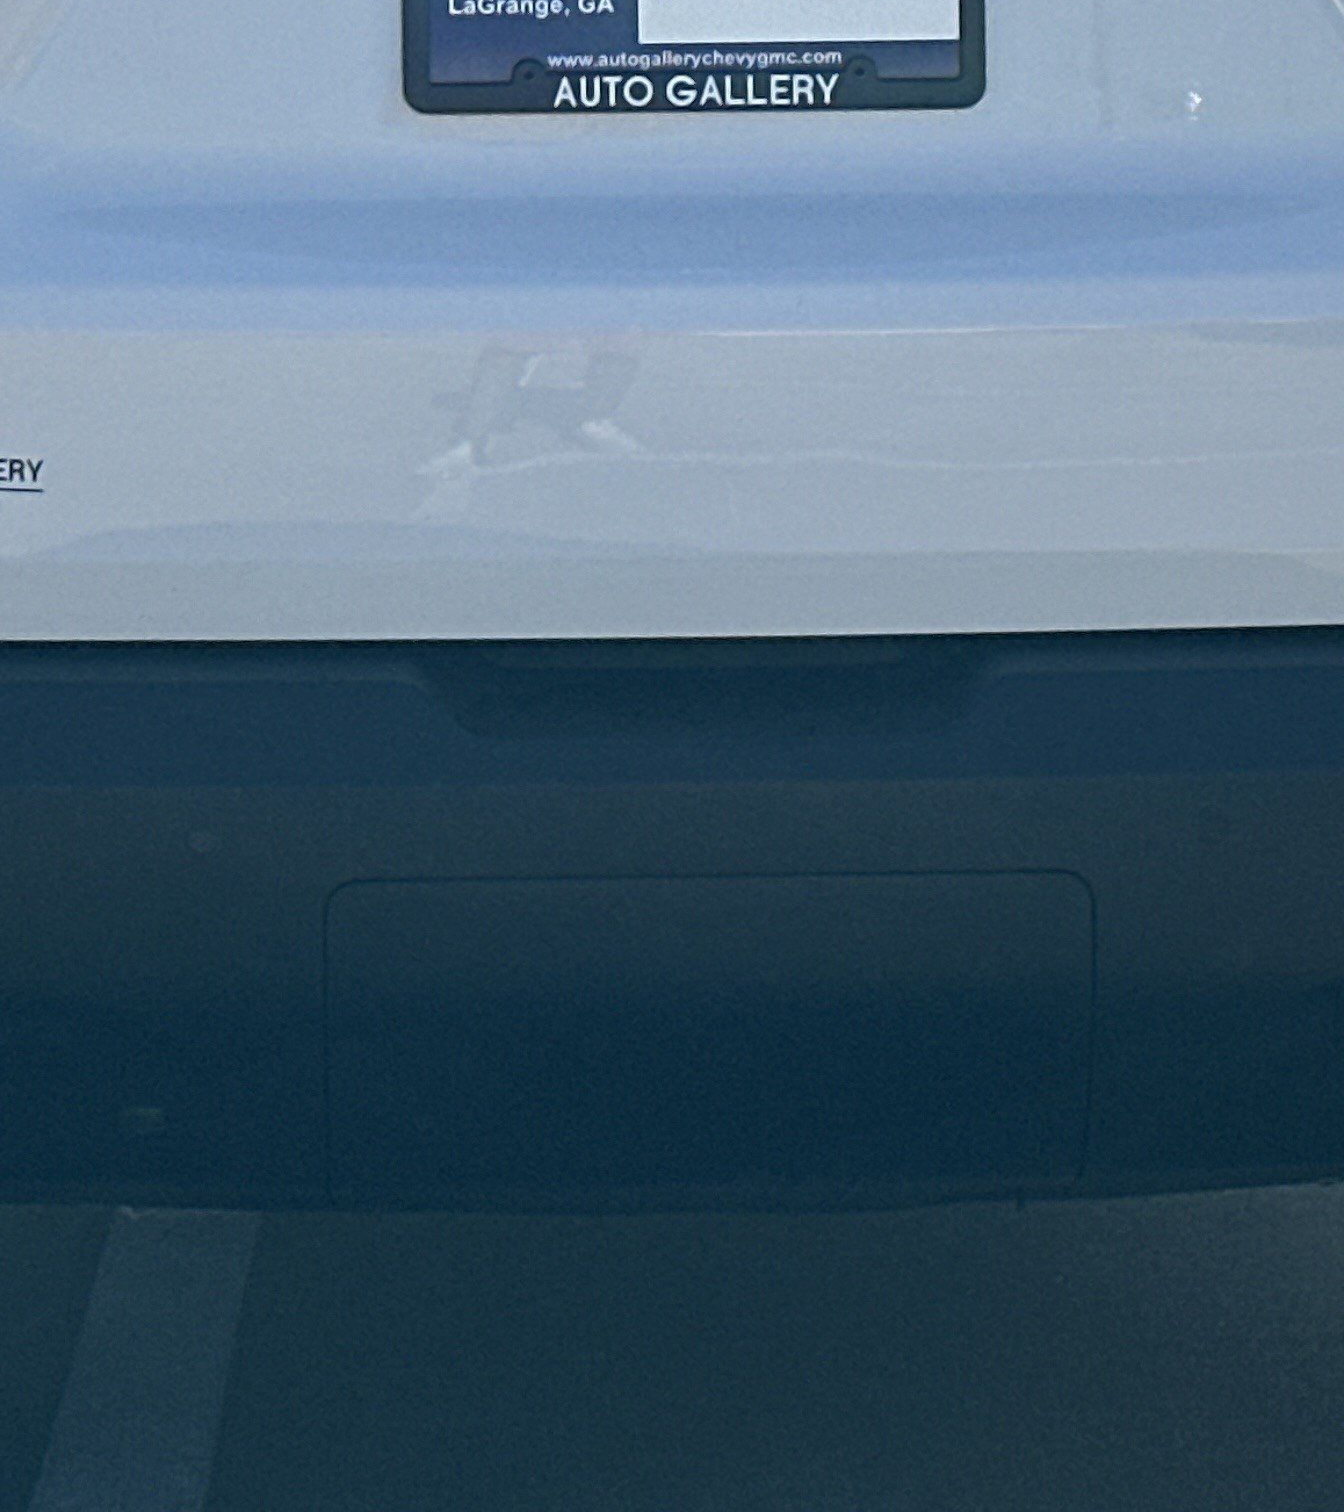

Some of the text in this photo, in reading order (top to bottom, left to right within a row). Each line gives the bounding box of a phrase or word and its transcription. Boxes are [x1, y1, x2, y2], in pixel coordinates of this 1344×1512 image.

[546, 50, 842, 70] www.autogallerychevygmc.com
[554, 73, 839, 108] AUTO GALLERY
